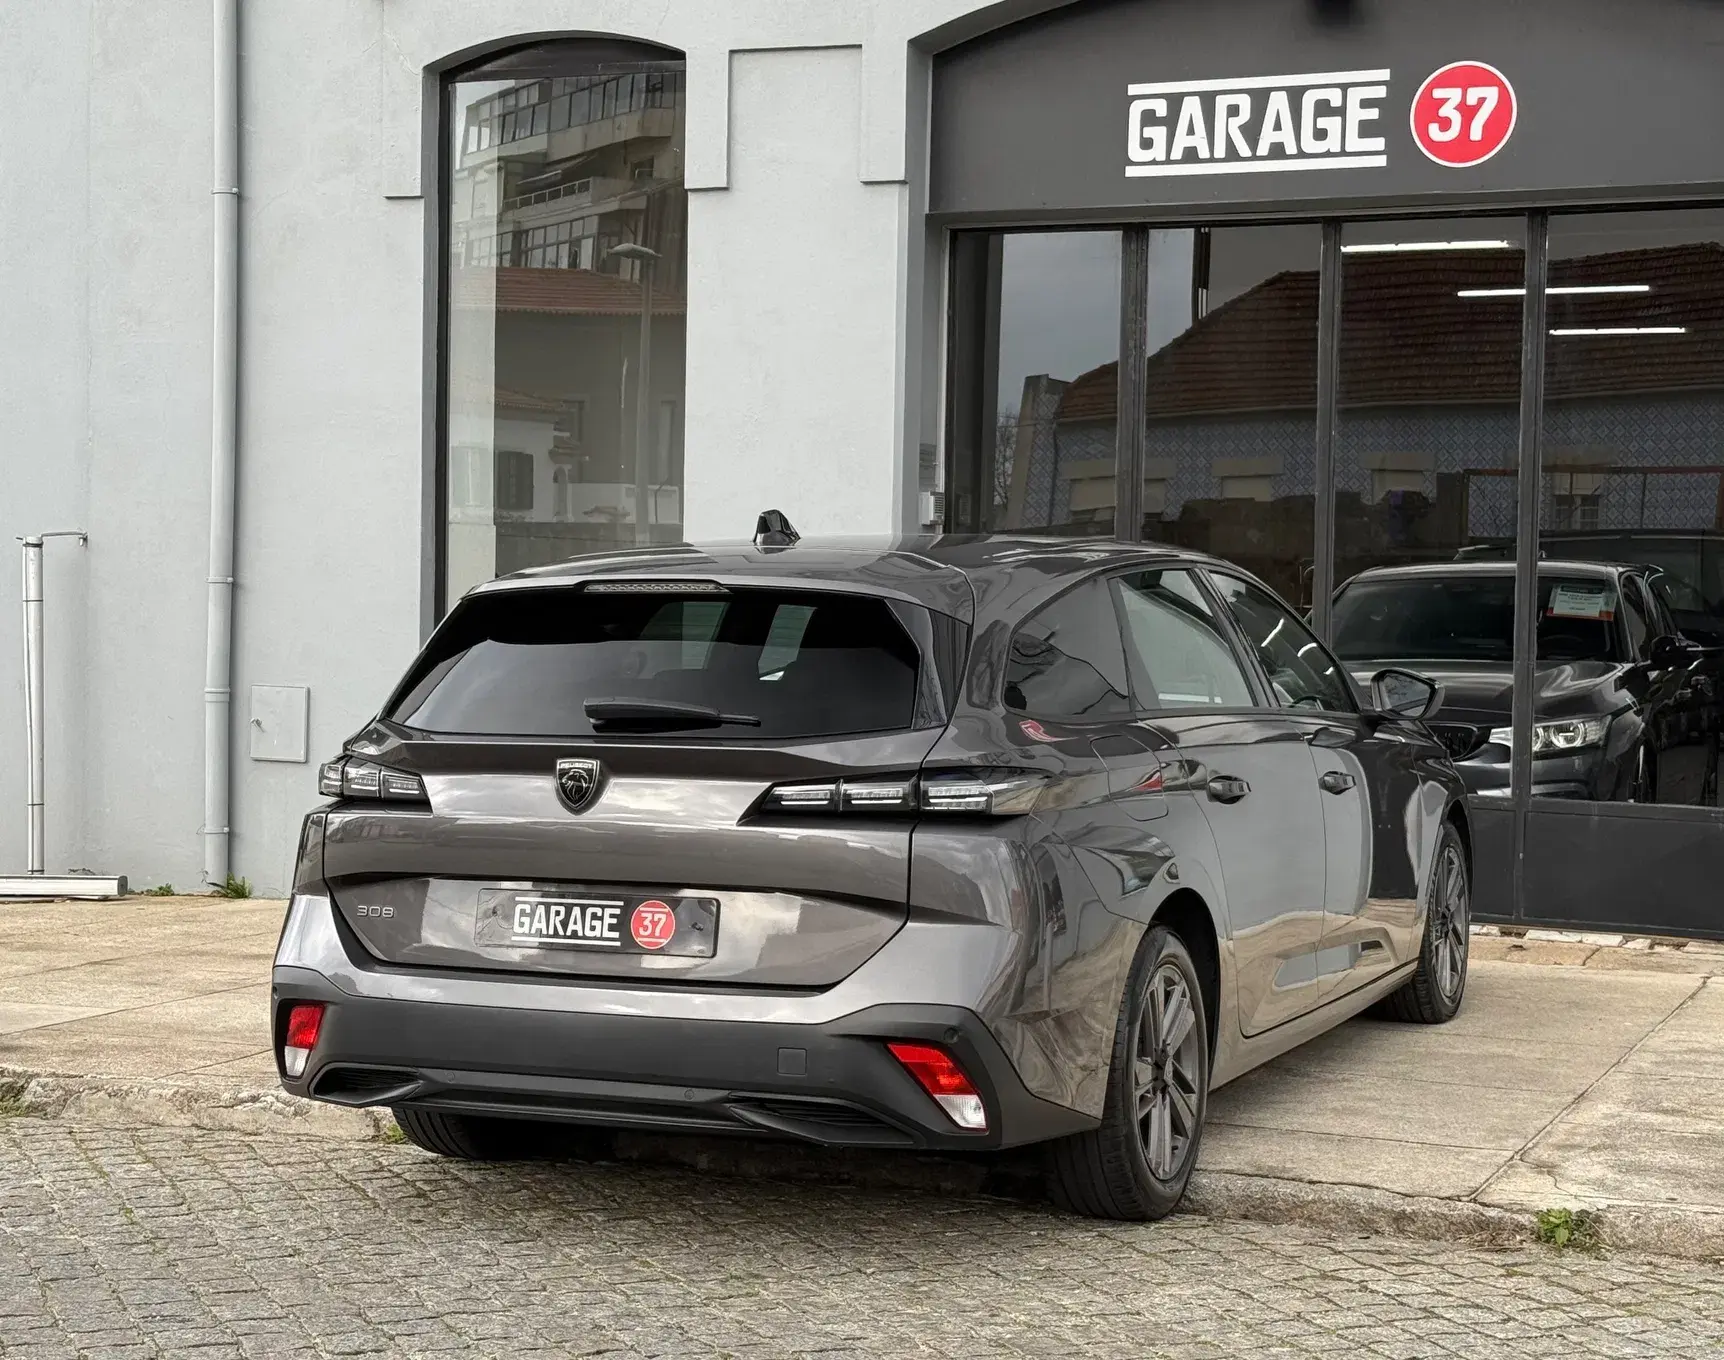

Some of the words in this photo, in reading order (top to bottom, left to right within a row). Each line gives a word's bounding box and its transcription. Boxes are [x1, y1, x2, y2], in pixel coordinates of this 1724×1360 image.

[1127, 85, 1387, 162] GARAGE
[1427, 86, 1499, 143] 37
[356, 905, 395, 918] 308
[512, 903, 621, 939] GARAGE
[638, 912, 667, 937] 37
